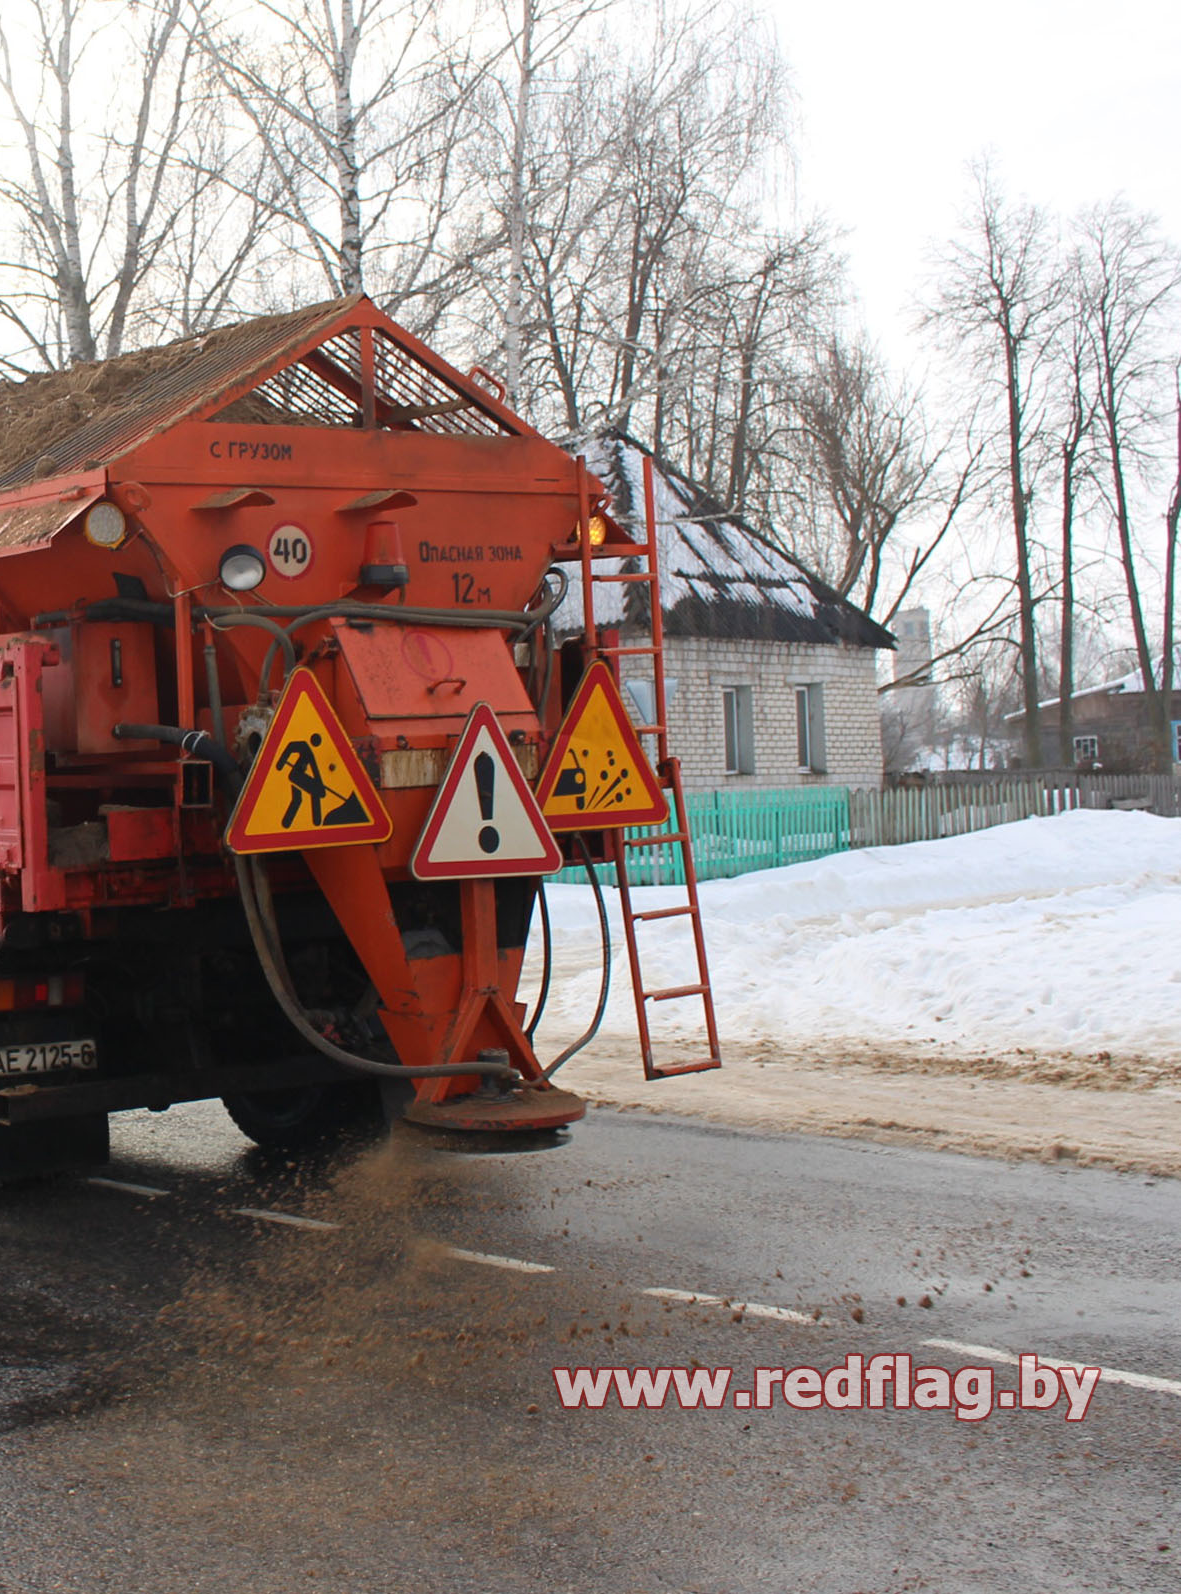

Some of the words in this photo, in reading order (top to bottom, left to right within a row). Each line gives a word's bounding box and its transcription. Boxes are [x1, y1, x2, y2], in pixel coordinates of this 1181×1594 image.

[210, 441, 221, 458] С
[228, 442, 292, 460] ГРУЗОМ
[273, 538, 307, 564] 40
[489, 545, 523, 562] ЗОНА
